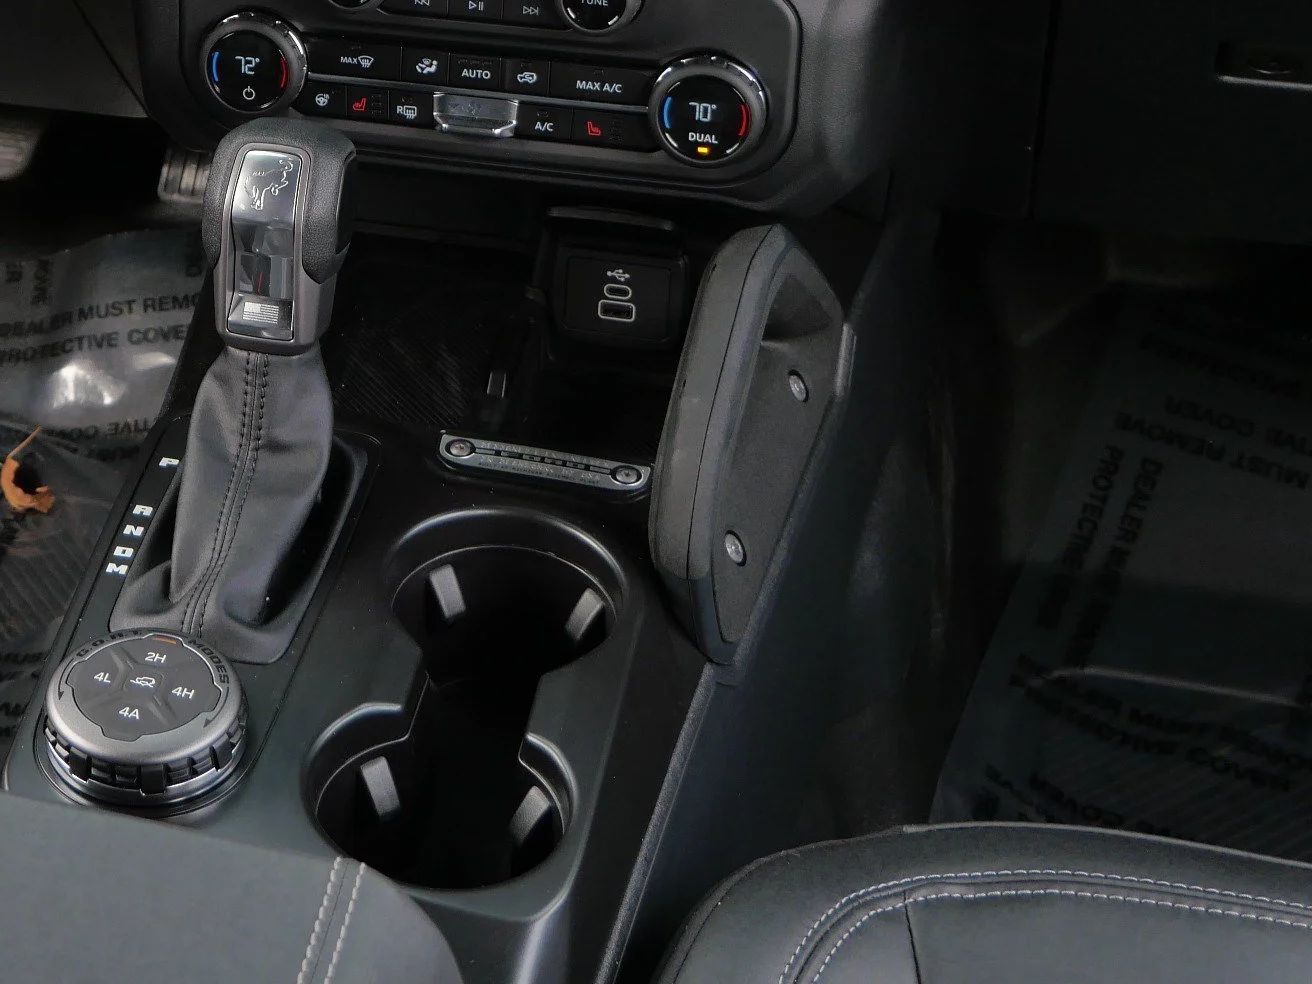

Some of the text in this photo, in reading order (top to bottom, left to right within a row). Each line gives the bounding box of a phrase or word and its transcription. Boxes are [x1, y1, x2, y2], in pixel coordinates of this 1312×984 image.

[340, 55, 358, 65] MAX
[461, 68, 491, 80] AUTO
[575, 79, 623, 94] MAX A/C
[534, 121, 554, 133] A/C
[688, 131, 719, 145] DUAL
[77, 298, 137, 321] MUST
[158, 456, 180, 467] P
[132, 504, 154, 516] R
[123, 524, 145, 537] N
[113, 545, 134, 558] D
[105, 562, 129, 575] M
[144, 651, 167, 664] 2H
[93, 671, 112, 684] 4L
[171, 686, 195, 699] 4H
[118, 706, 140, 720] 4A
